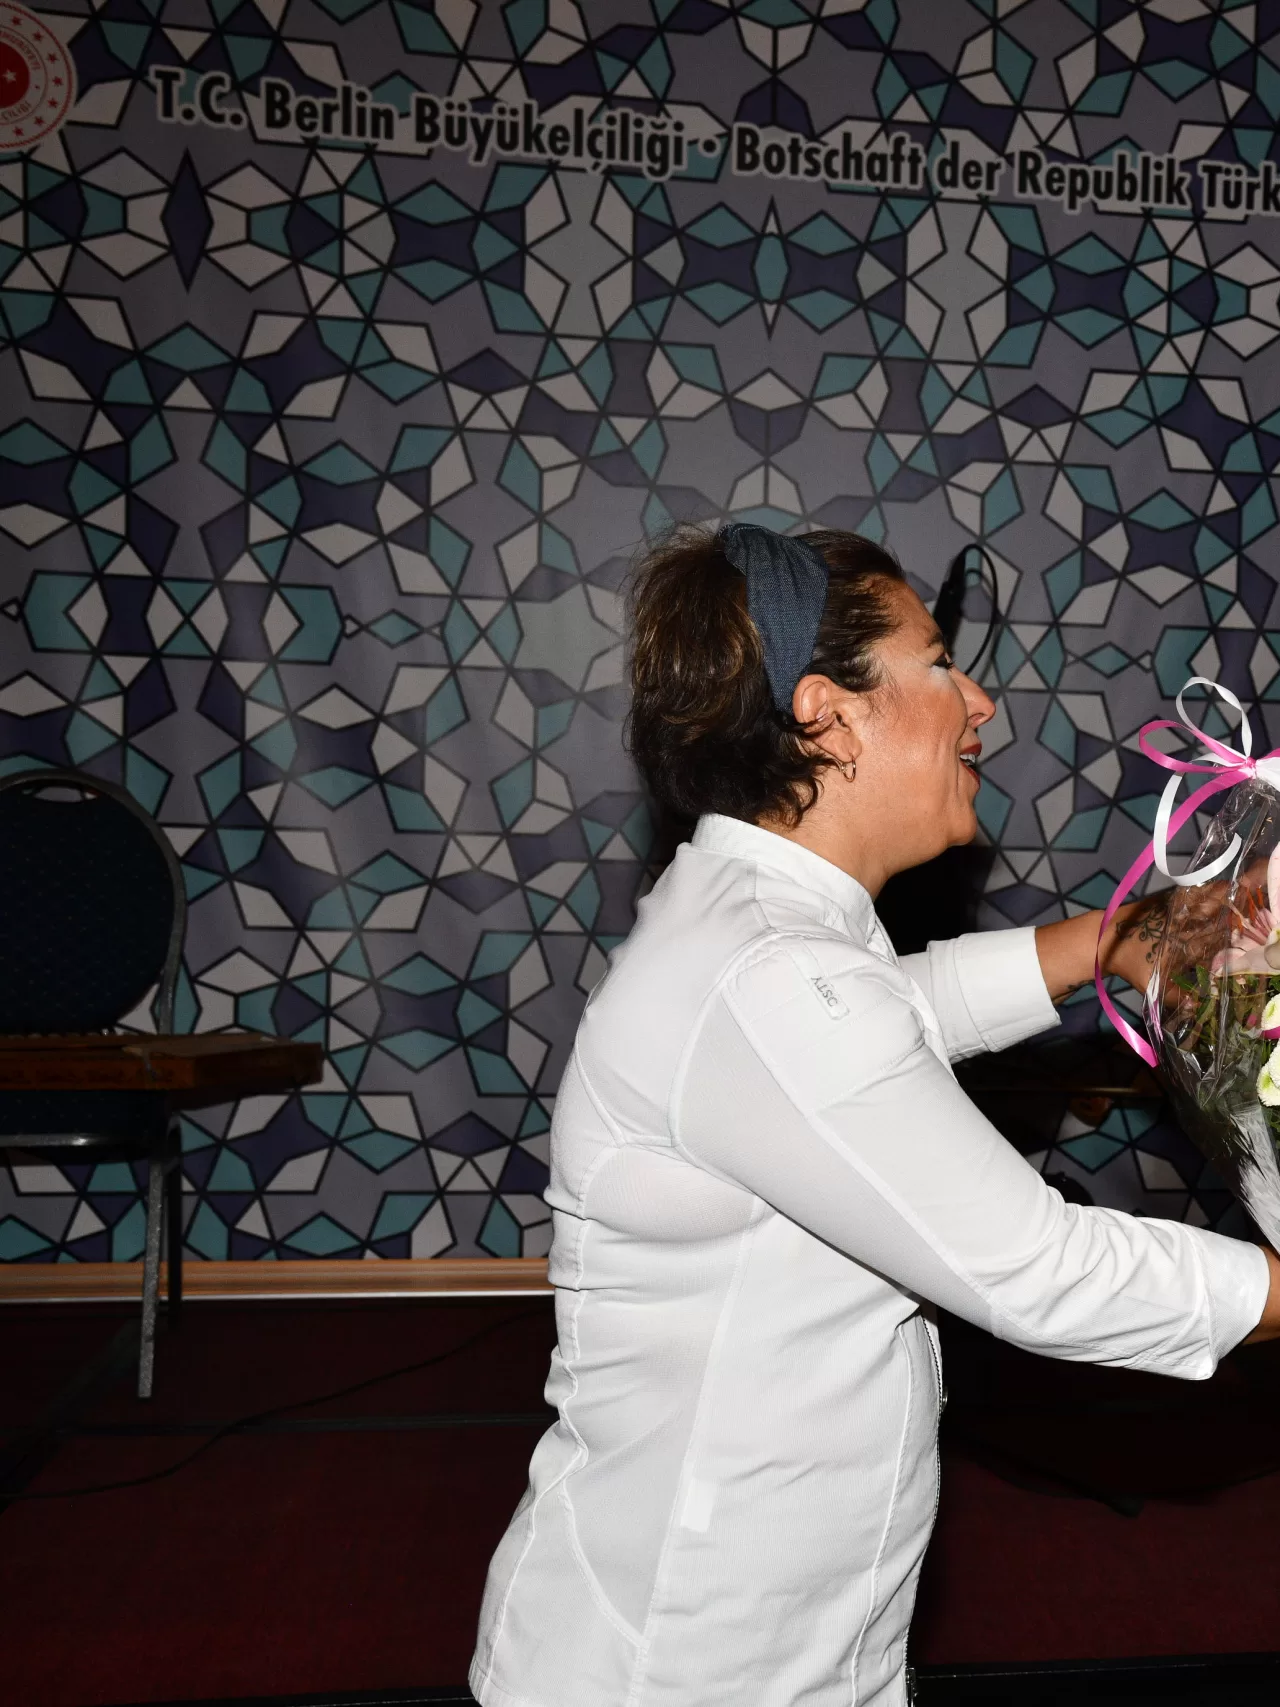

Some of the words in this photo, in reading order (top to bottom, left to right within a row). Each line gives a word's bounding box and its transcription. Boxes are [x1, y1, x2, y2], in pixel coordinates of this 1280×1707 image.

[153, 70, 244, 125] T.C.
[264, 83, 395, 140] Berlin
[415, 98, 685, 176] Büyükelçiliği
[735, 127, 922, 185] Botschaft
[936, 141, 1001, 191] der
[1018, 151, 1189, 209] Republik
